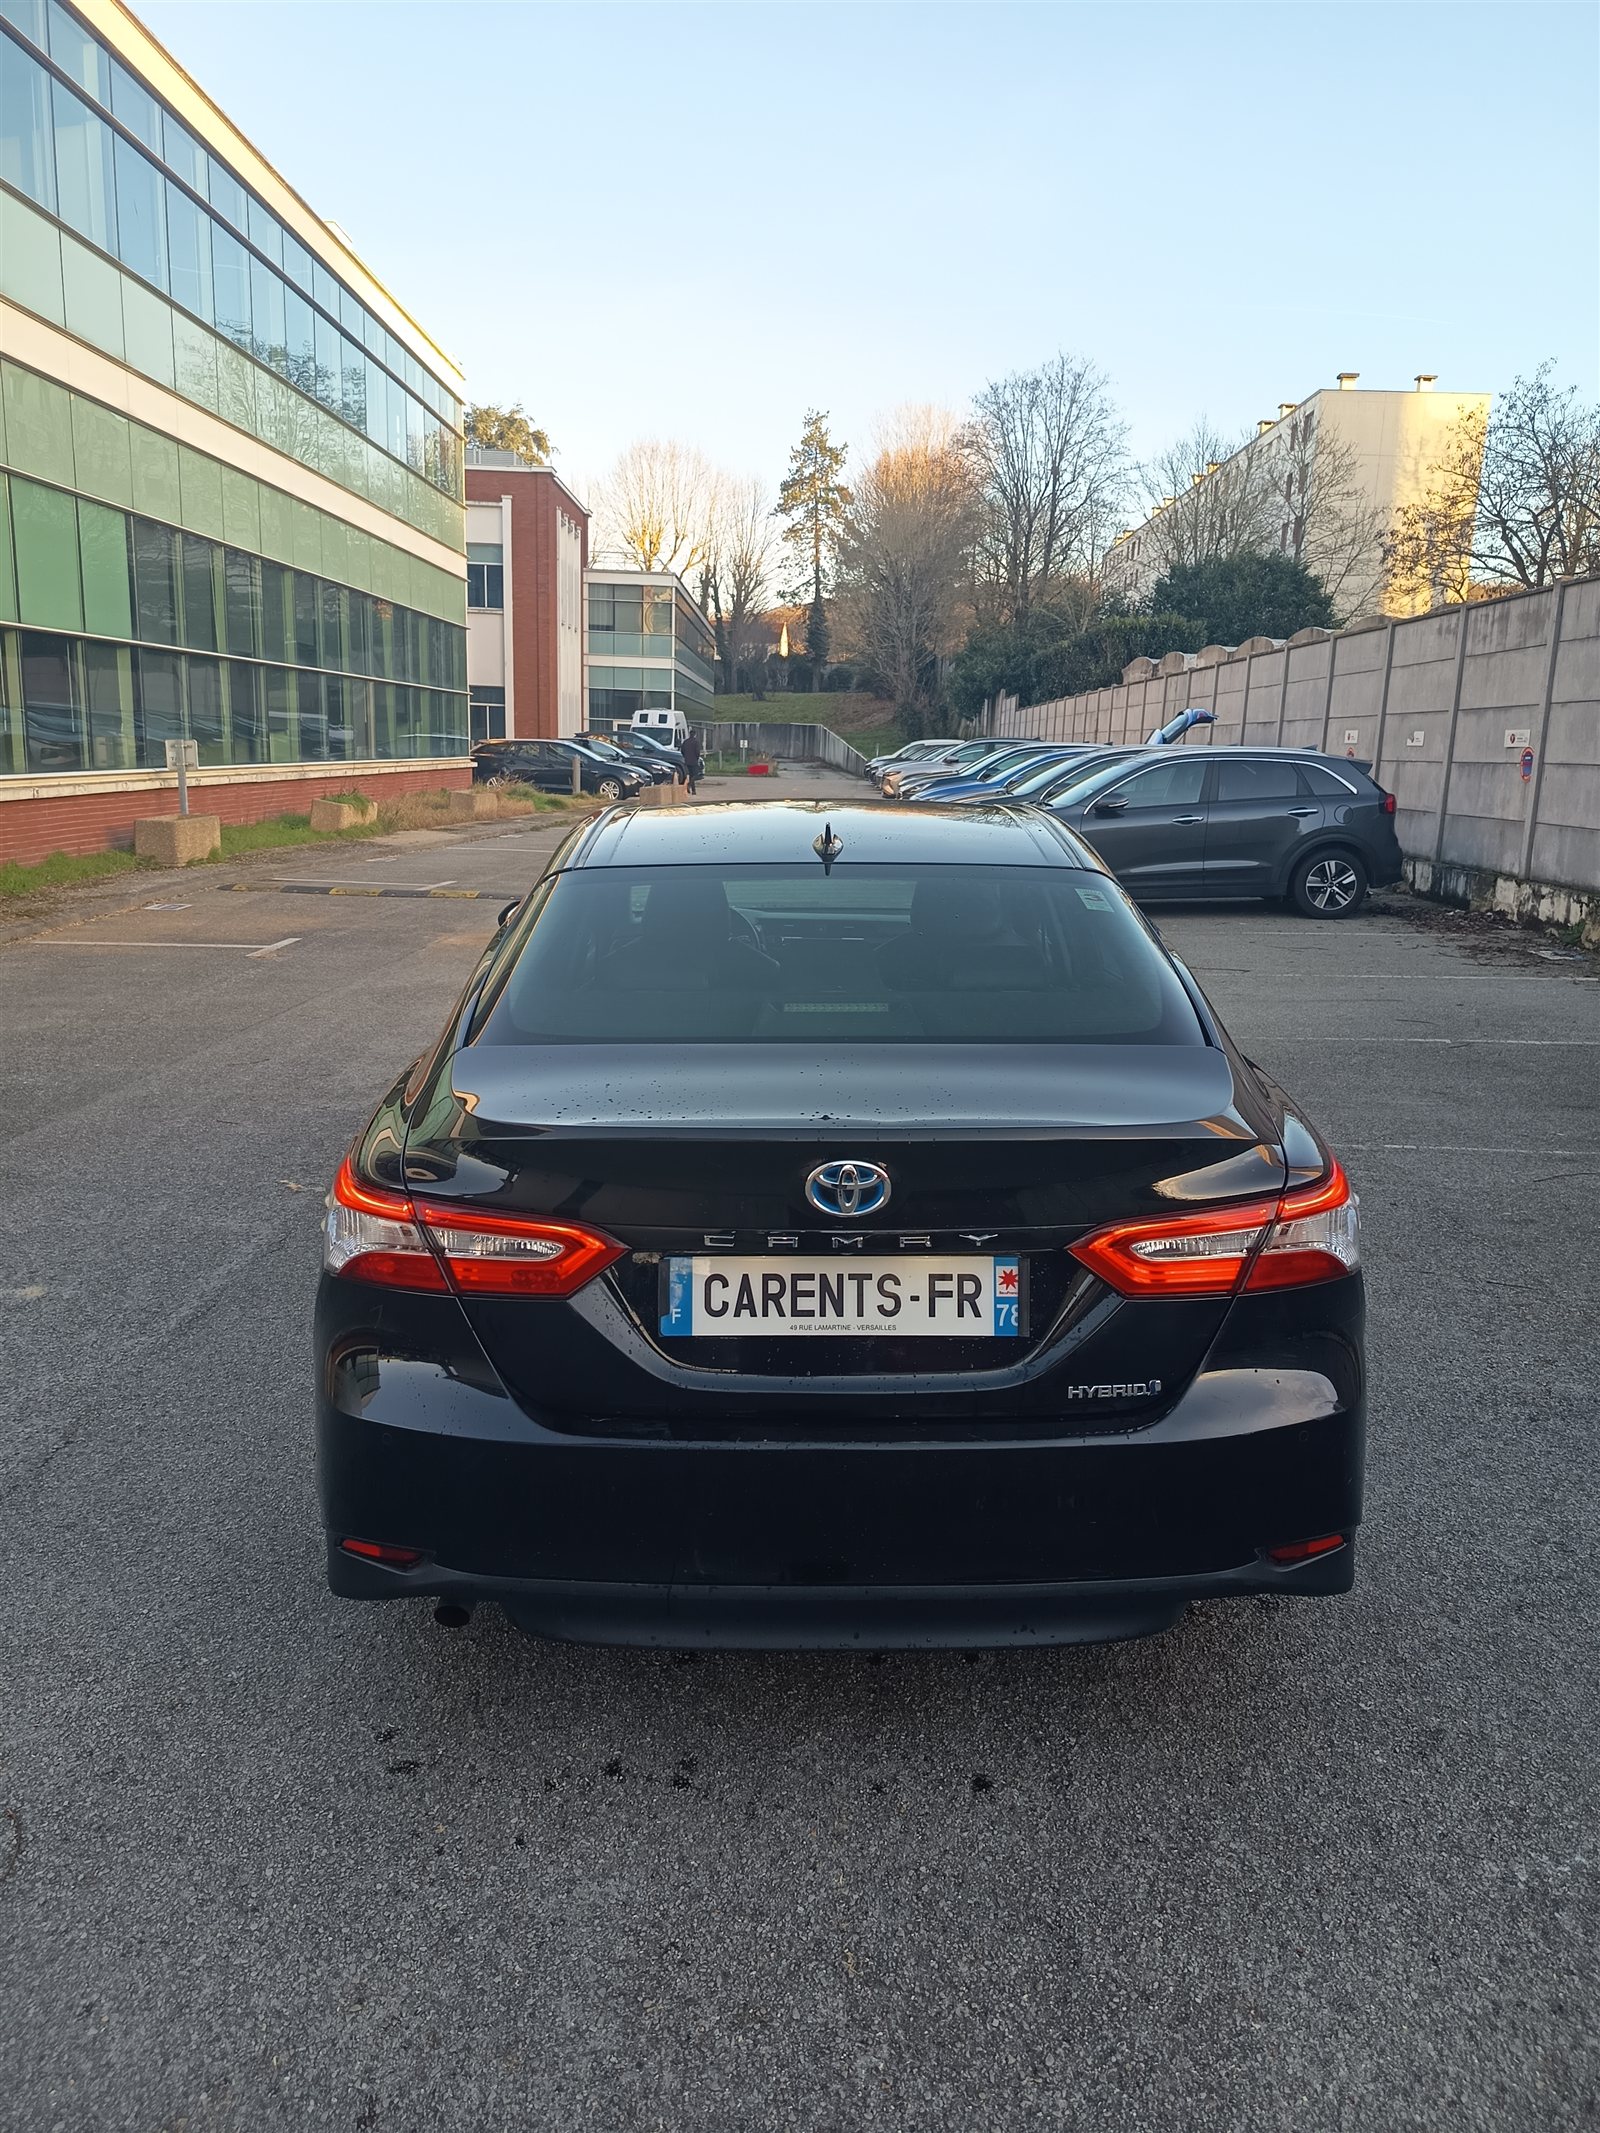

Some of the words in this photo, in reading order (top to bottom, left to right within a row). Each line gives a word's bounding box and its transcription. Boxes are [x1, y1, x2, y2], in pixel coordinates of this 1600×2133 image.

[704, 1233, 998, 1248] CAMRY
[704, 1273, 983, 1318] CARENTS-FR
[671, 1308, 682, 1325] F
[1067, 1383, 1147, 1399] HYBRID
